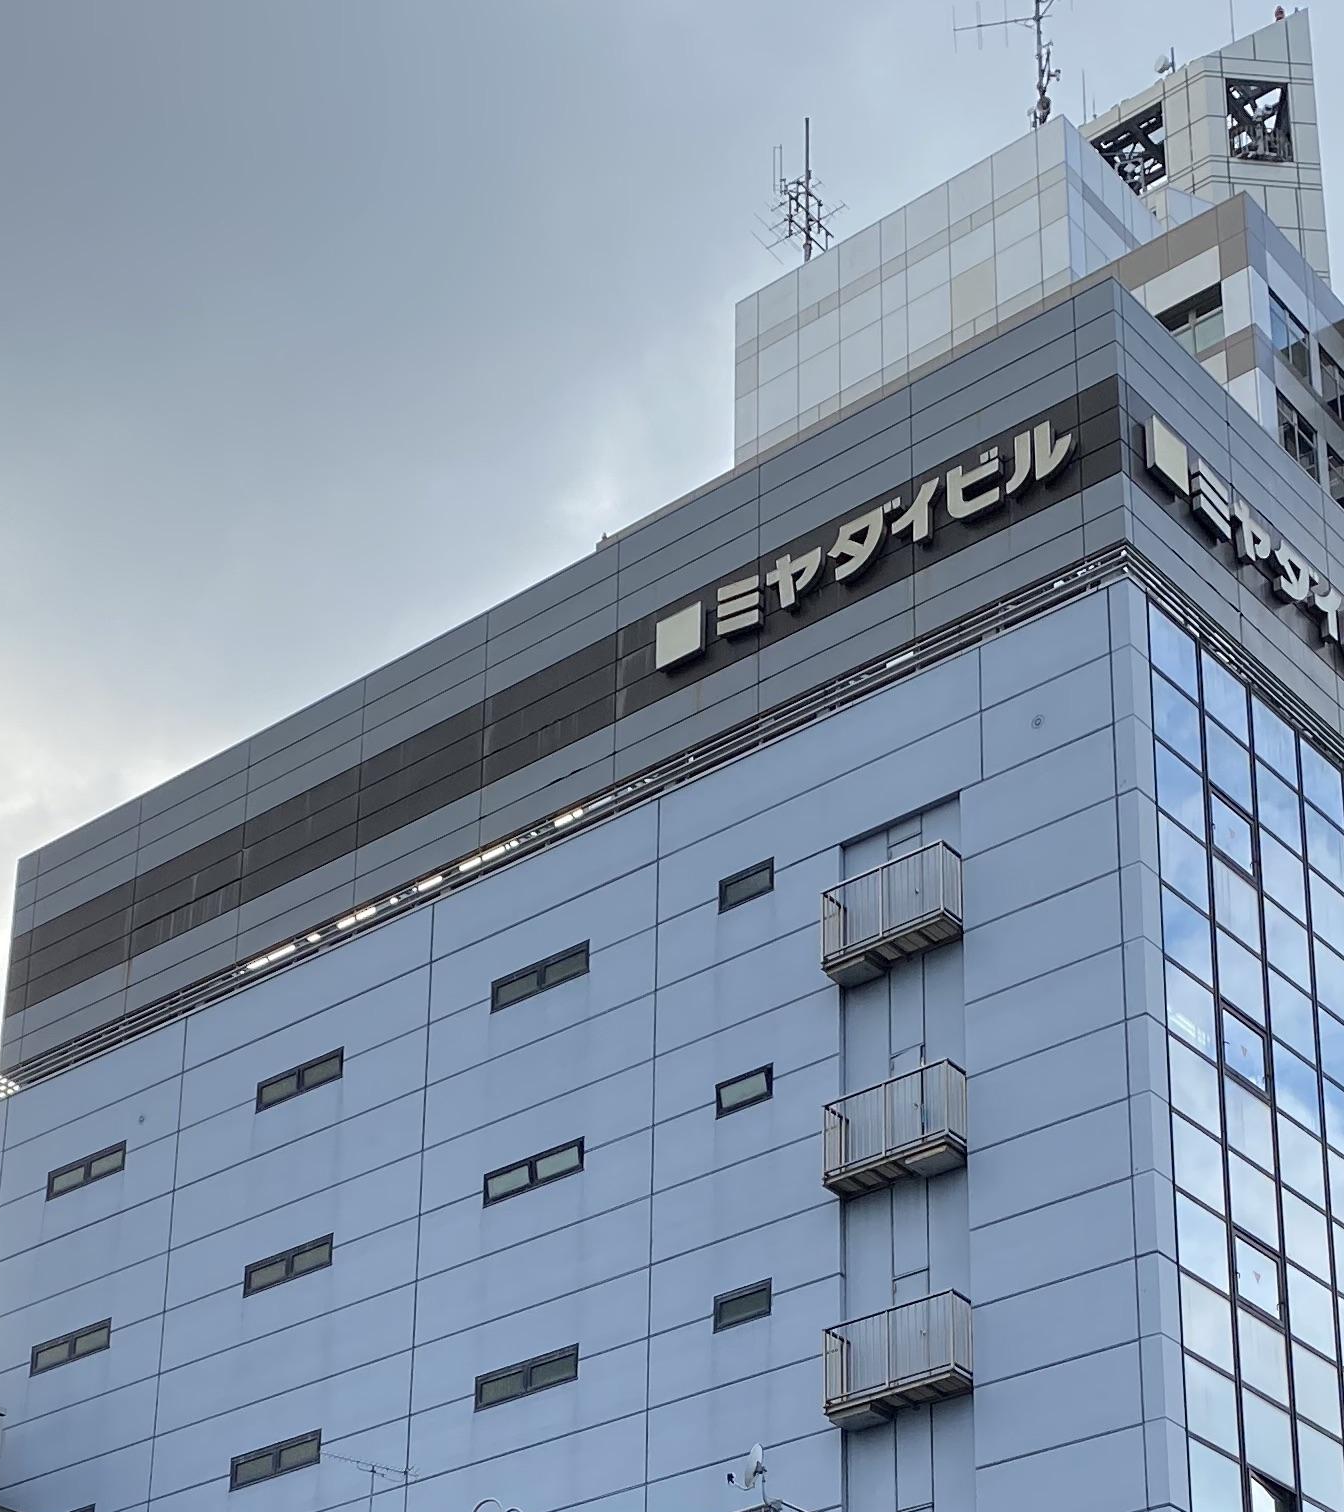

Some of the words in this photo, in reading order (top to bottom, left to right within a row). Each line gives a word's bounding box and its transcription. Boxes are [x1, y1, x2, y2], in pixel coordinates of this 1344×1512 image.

[717, 420, 1074, 637] ミヤダイビル
